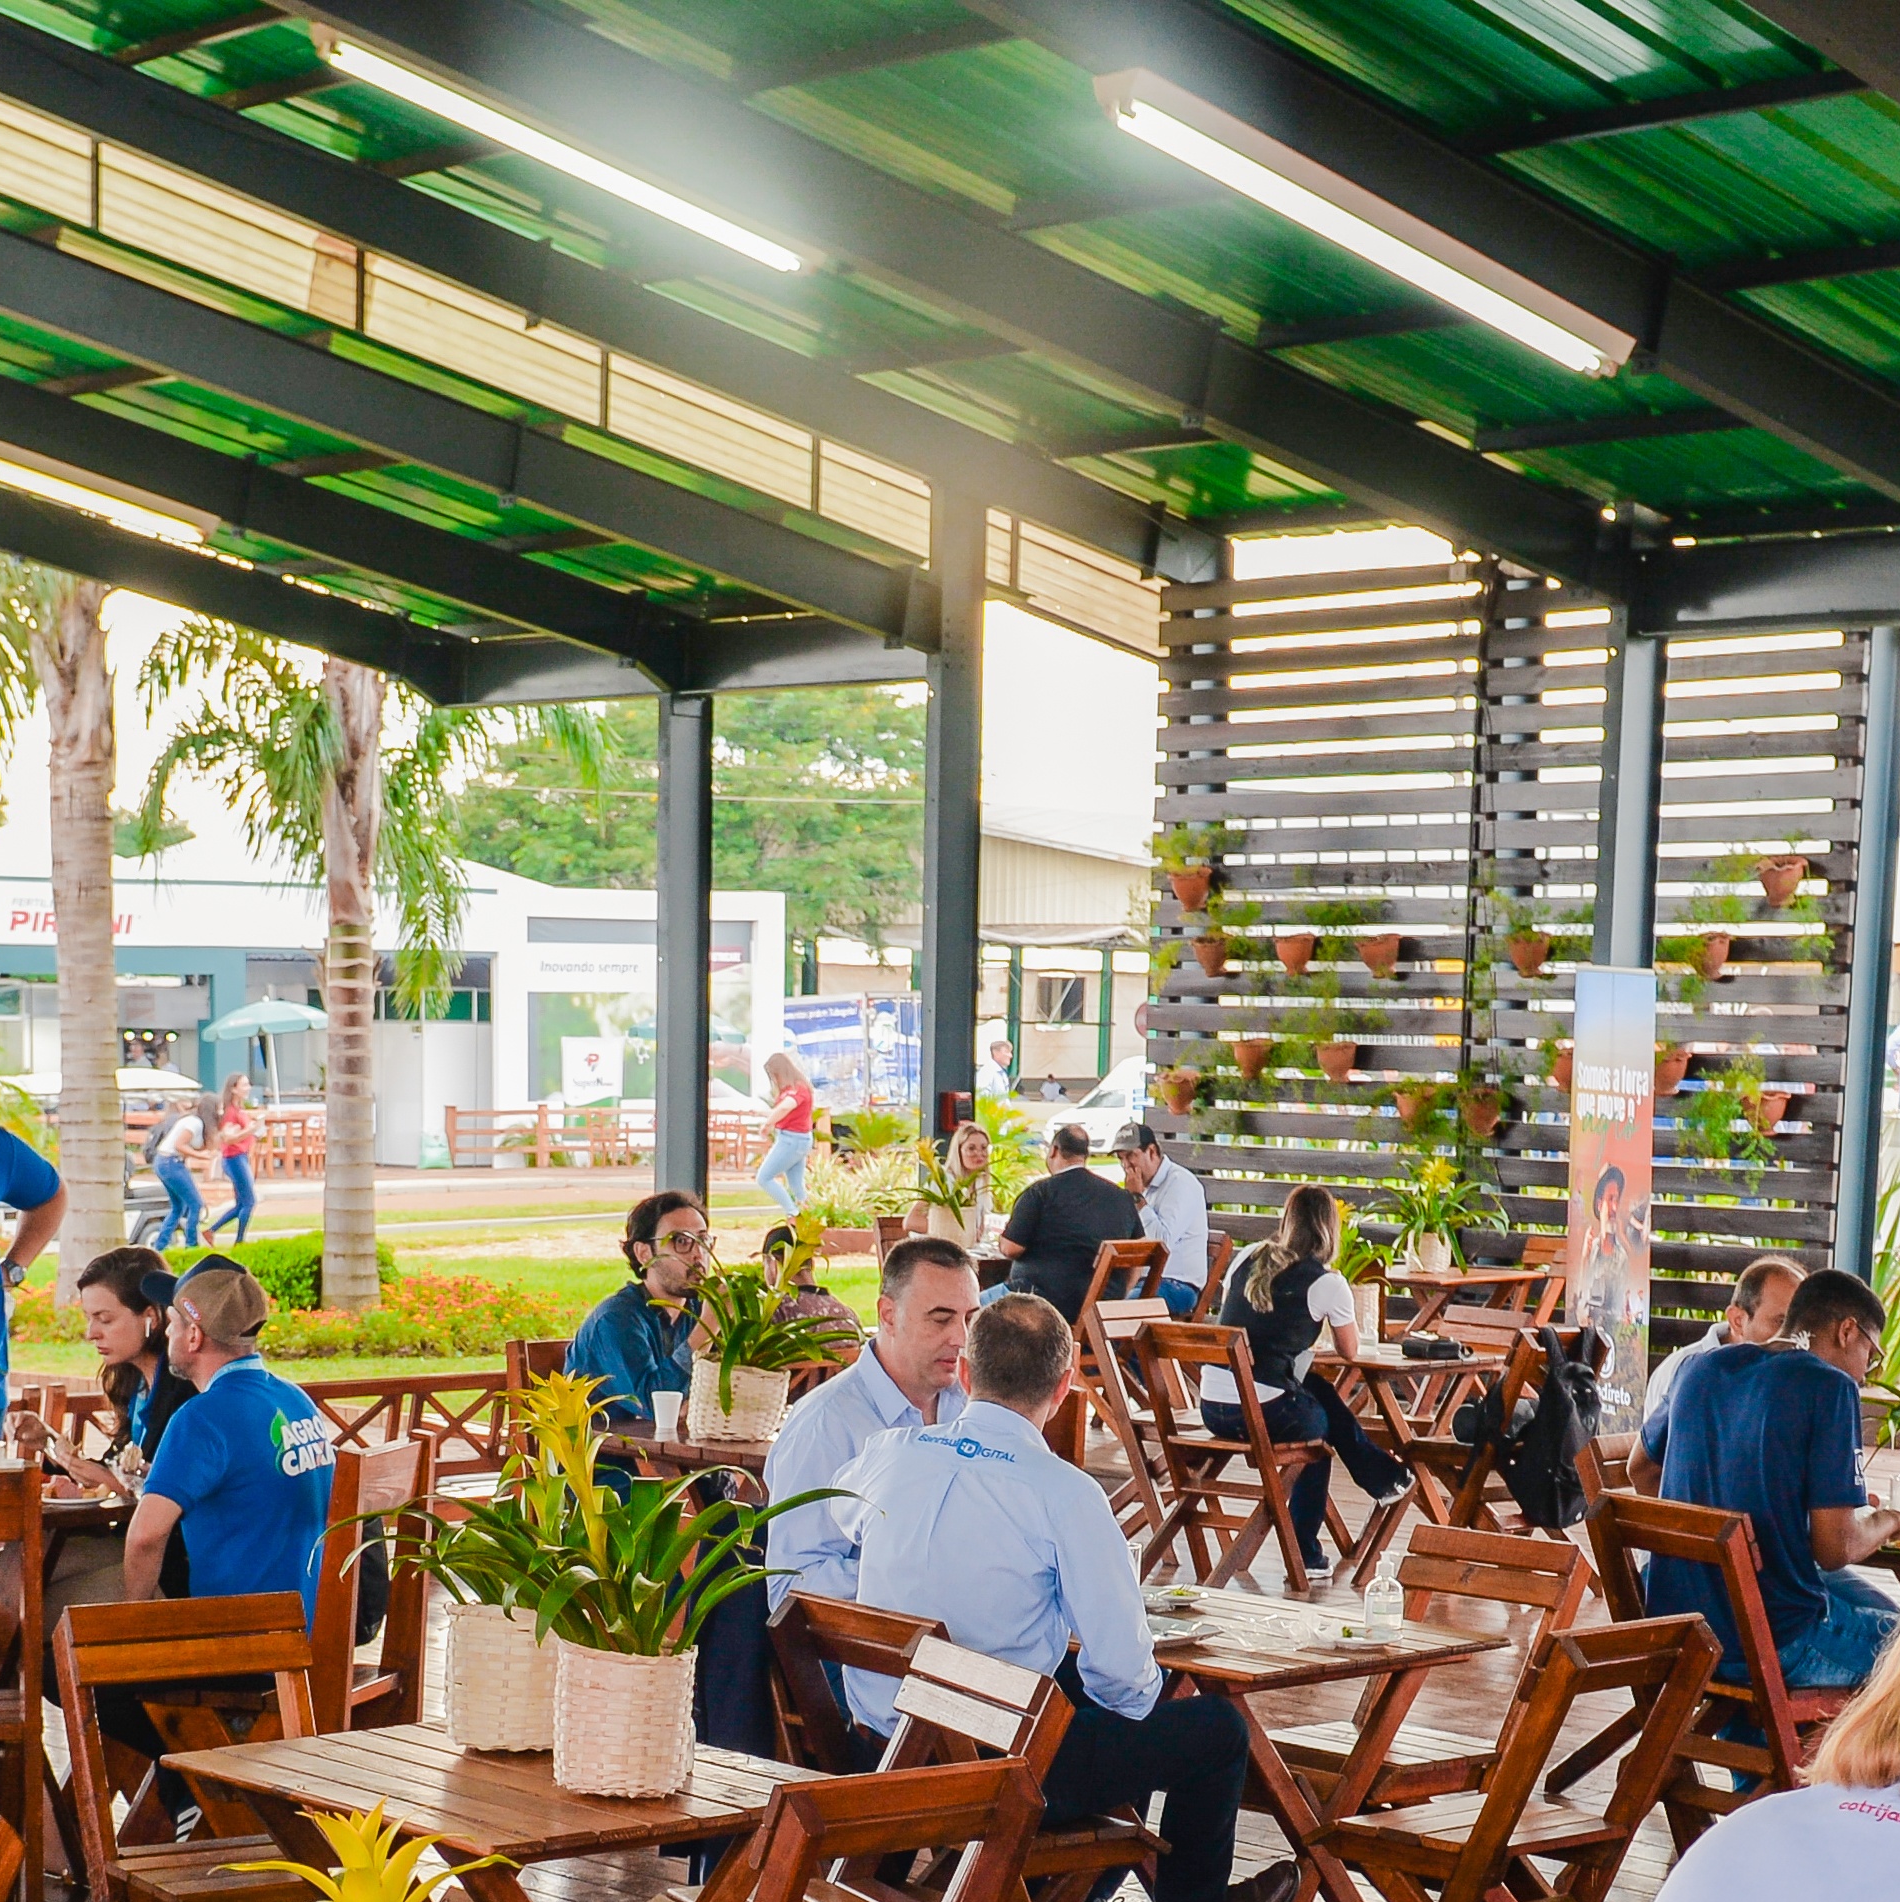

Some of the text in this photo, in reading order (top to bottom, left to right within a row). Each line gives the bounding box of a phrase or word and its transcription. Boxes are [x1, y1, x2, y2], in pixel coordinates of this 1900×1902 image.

[539, 960, 595, 973] Inovando
[1577, 1061, 1649, 1105] Somos a força
[1576, 1092, 1596, 1120] que
[1597, 1094, 1626, 1123] move
[280, 1415, 327, 1450] AGRO
[282, 1441, 337, 1477] CAIXA
